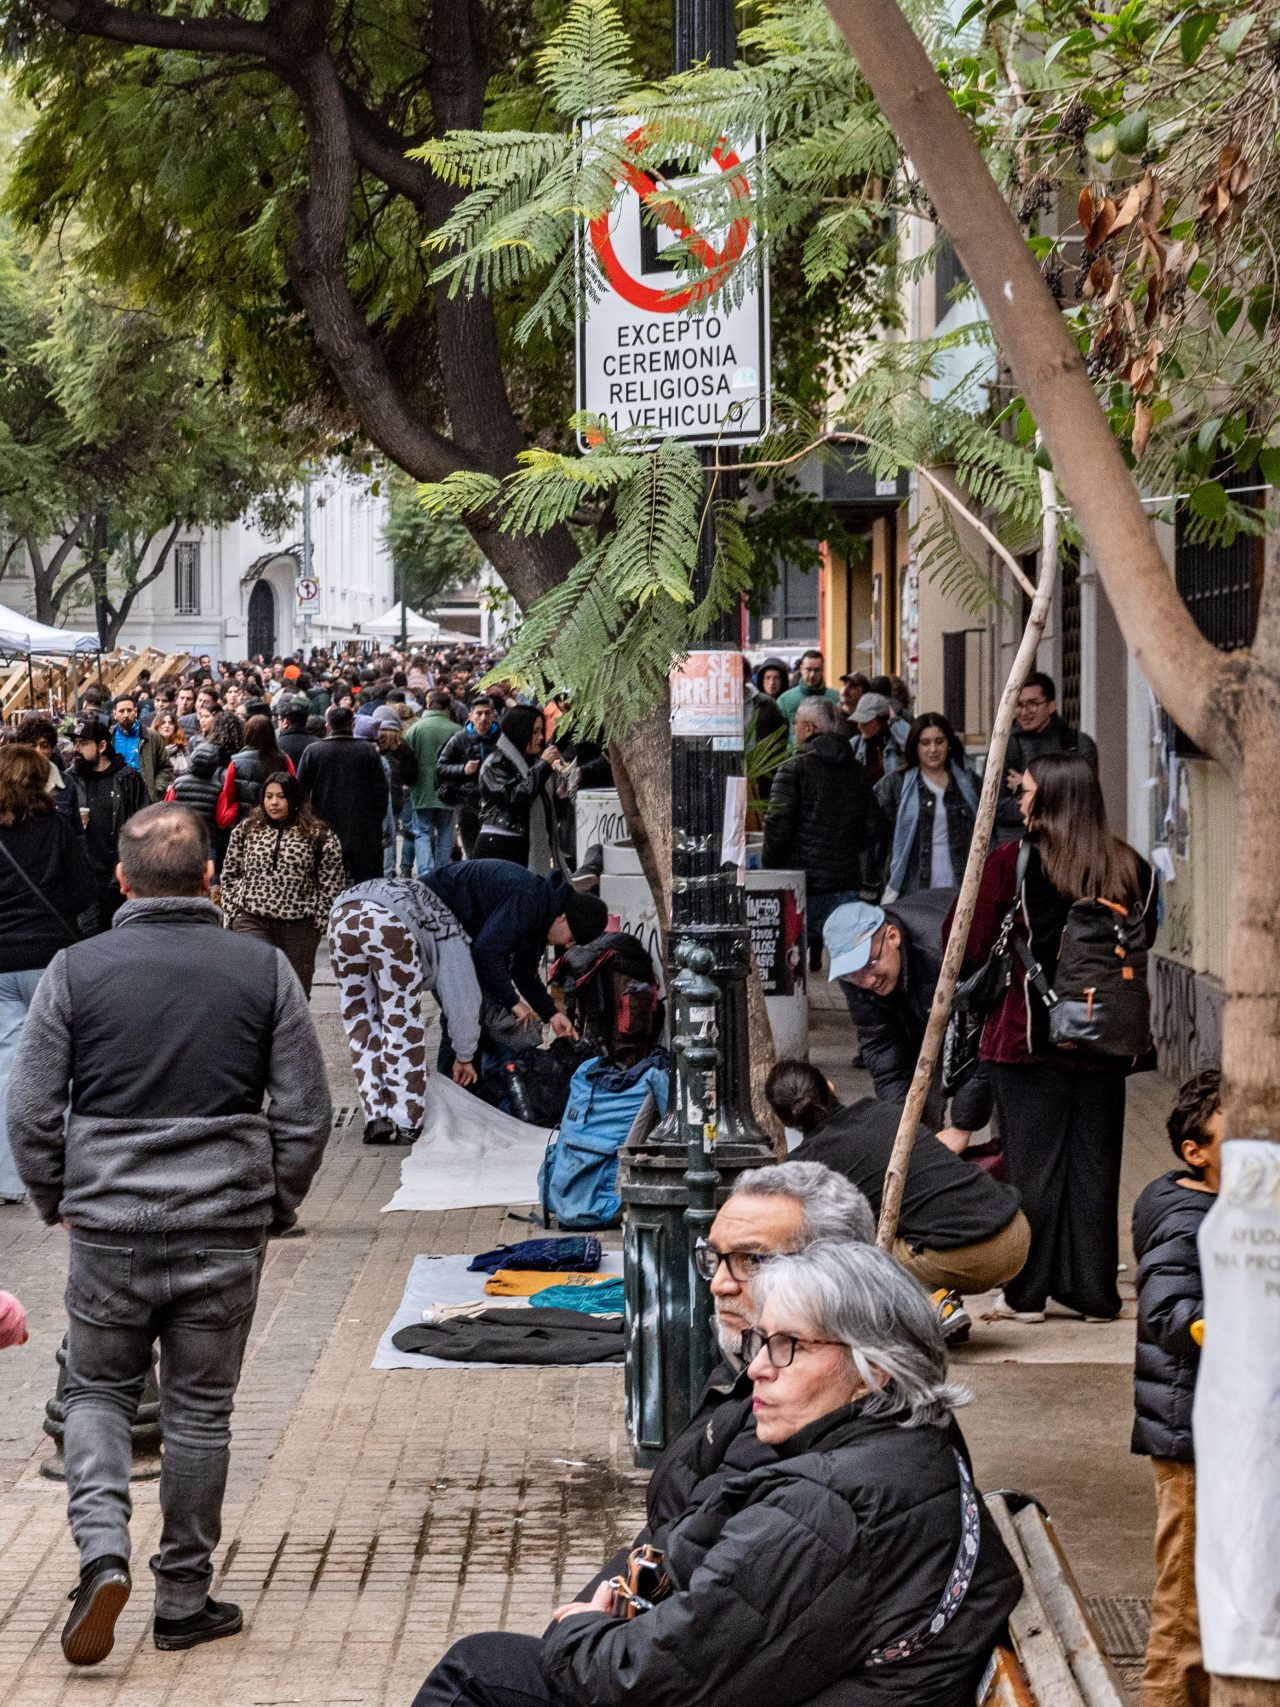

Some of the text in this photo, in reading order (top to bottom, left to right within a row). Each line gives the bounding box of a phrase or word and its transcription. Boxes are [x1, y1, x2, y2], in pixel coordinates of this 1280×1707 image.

[617, 316, 722, 348] EXCEPTO
[603, 344, 738, 377] CEREMONIA
[609, 373, 731, 405] RELIGIOSA
[628, 400, 744, 429] VEHICULO
